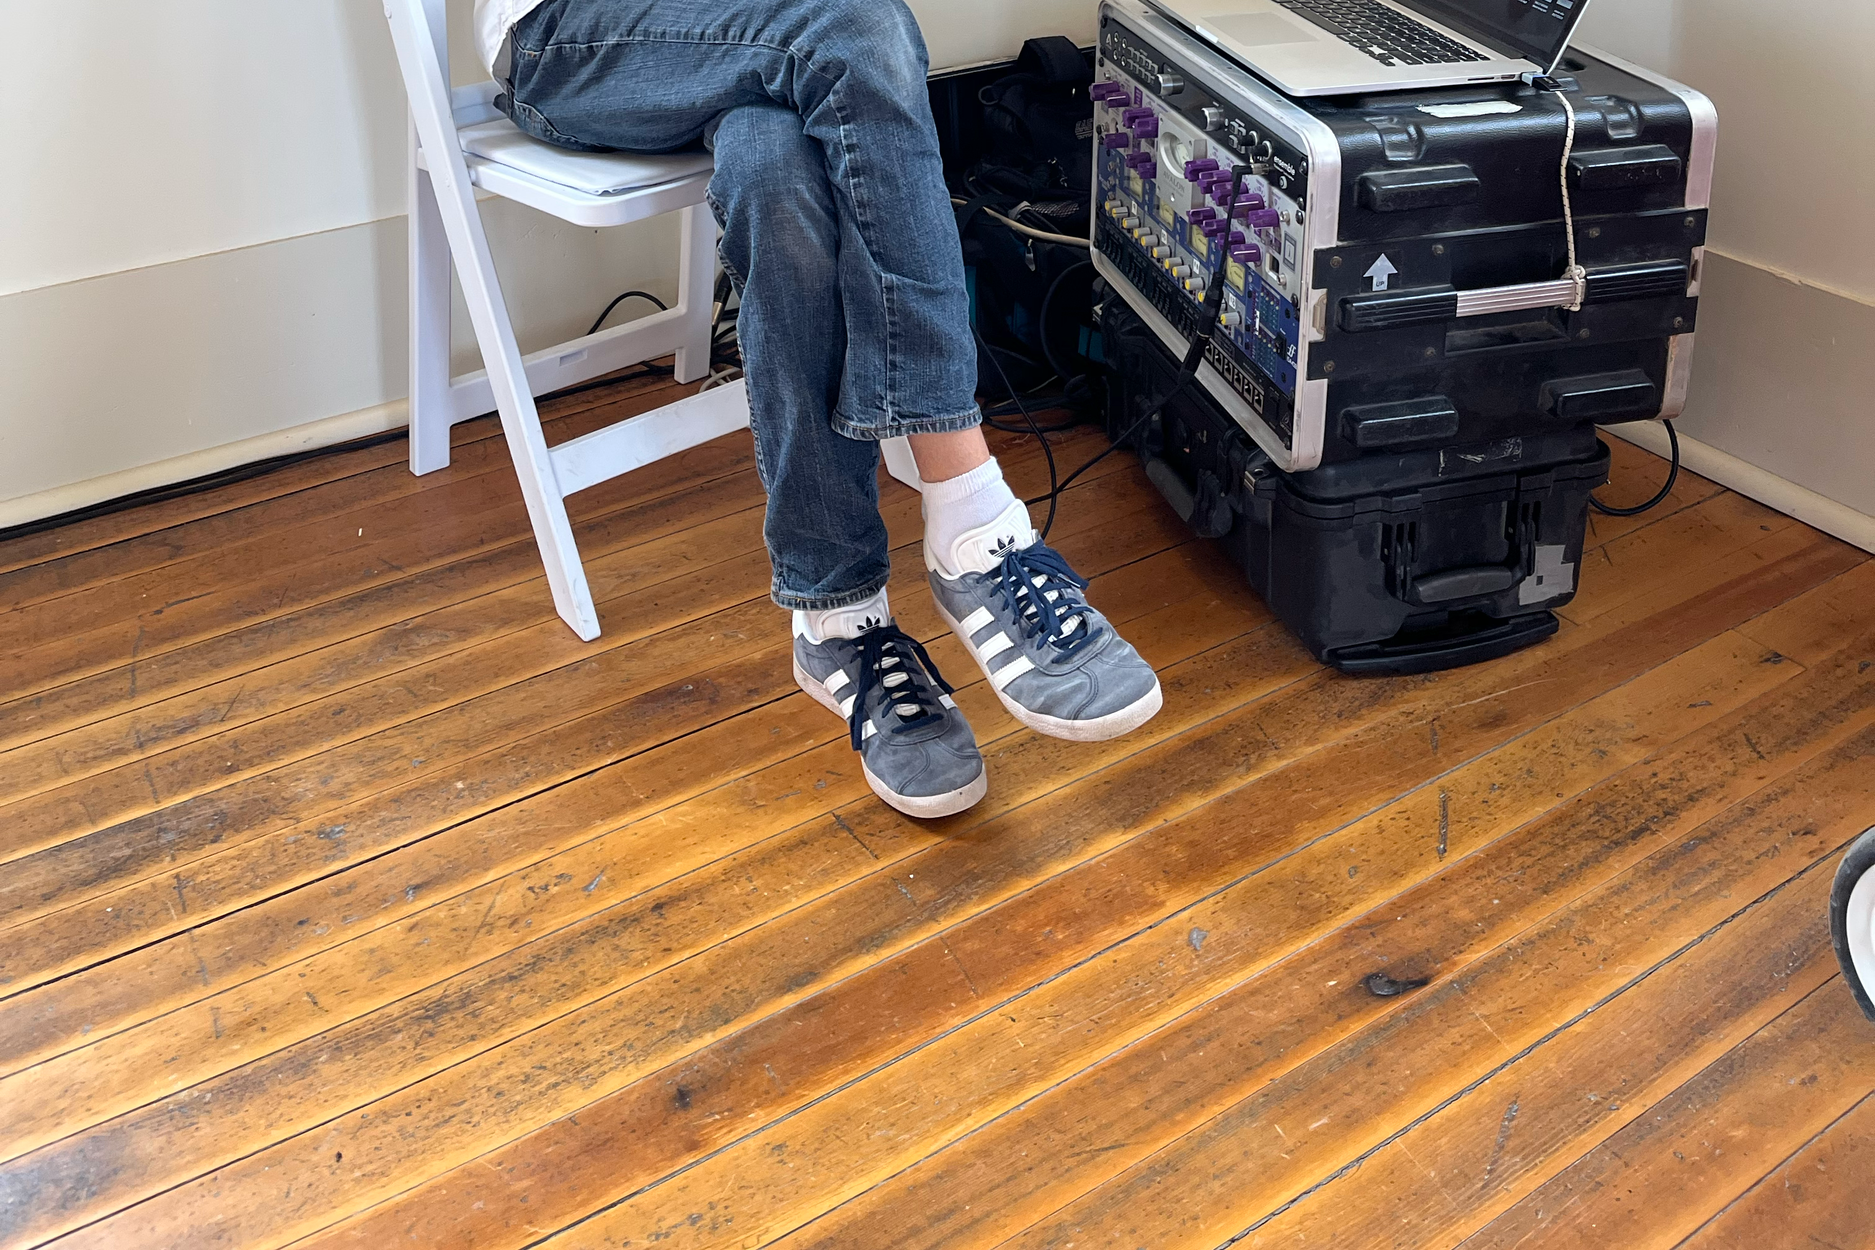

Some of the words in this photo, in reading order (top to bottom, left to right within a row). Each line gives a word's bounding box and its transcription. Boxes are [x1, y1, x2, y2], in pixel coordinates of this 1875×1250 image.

[1273, 155, 1296, 176] ensemble
[1163, 170, 1186, 193] AVALON
[1375, 280, 1385, 288] UP
